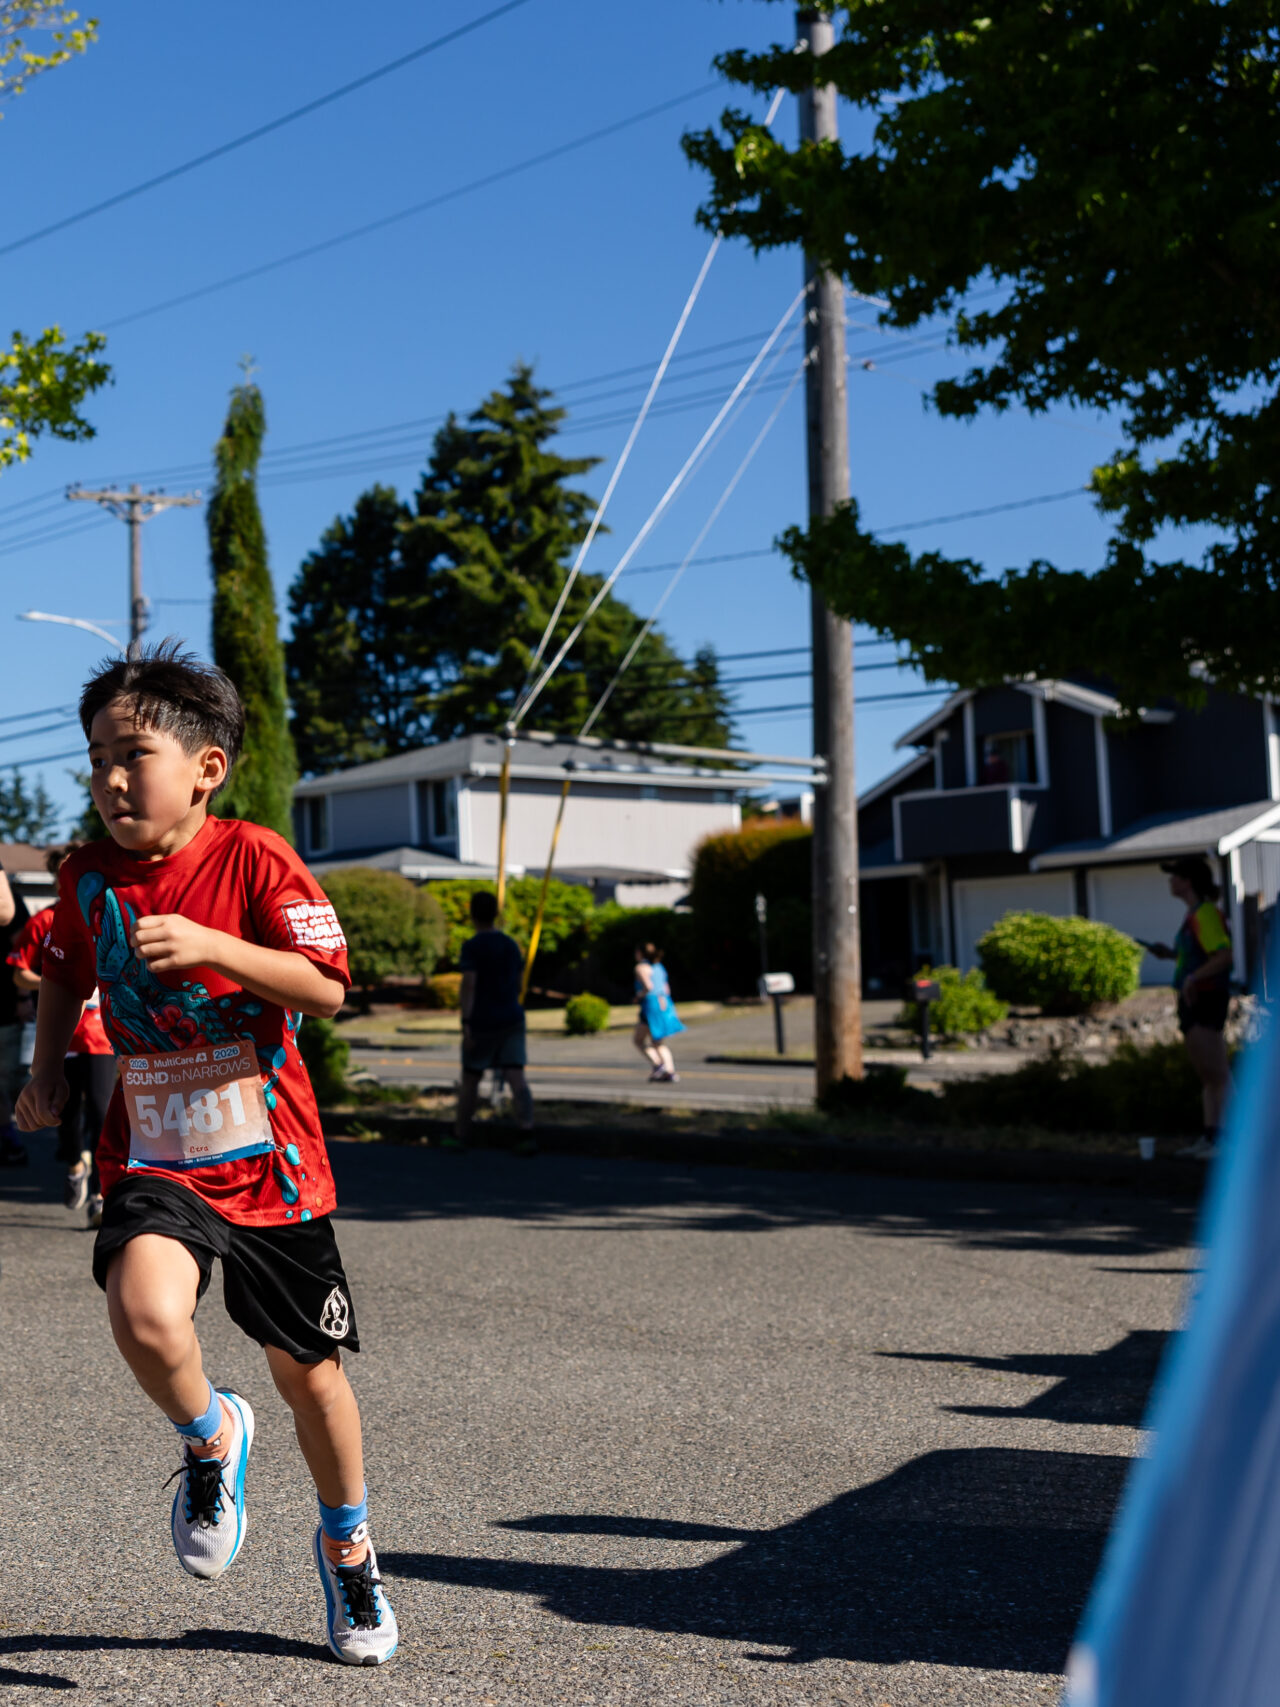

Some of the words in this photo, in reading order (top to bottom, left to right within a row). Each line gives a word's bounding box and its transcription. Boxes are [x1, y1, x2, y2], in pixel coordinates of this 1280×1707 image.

[126, 1071, 169, 1085] SOUND
[171, 1073, 181, 1083] to
[182, 1056, 251, 1081] NARROWS
[130, 1058, 148, 1070] 2026
[153, 1056, 195, 1069] MultiCare
[214, 1046, 239, 1060] 2026
[134, 1081, 247, 1139] 5481
